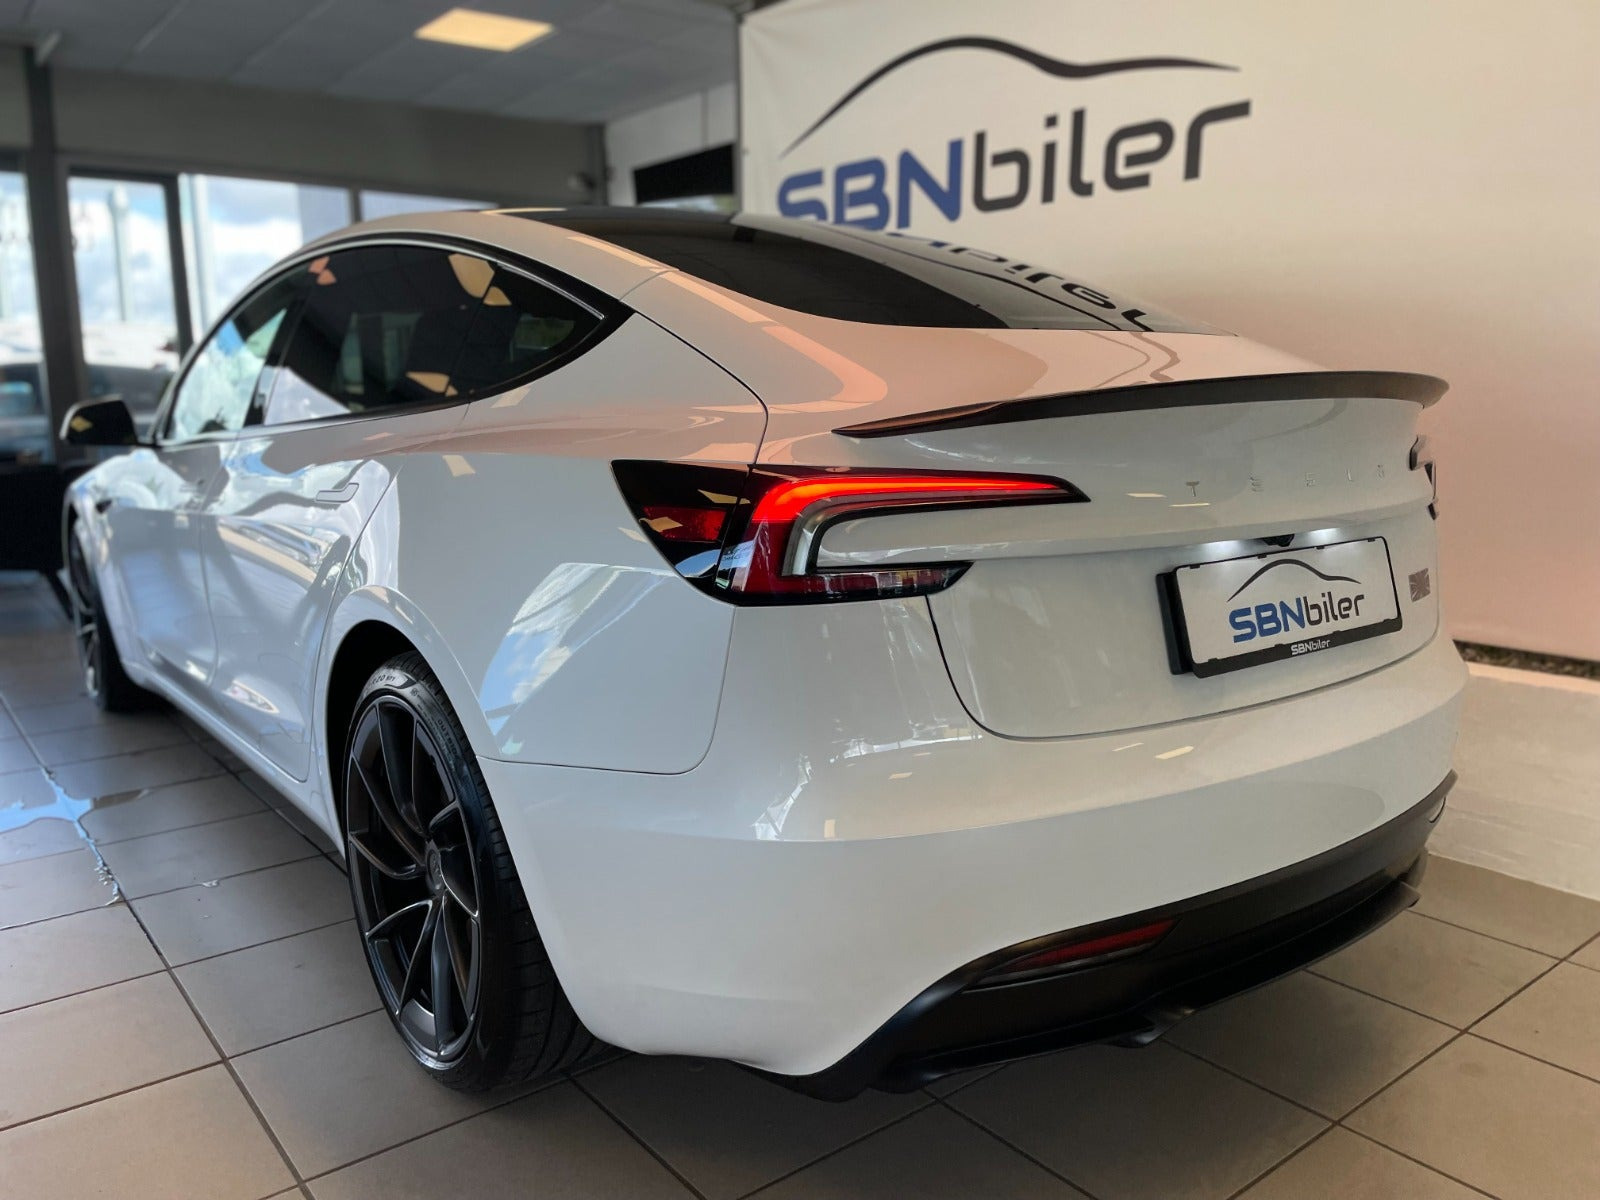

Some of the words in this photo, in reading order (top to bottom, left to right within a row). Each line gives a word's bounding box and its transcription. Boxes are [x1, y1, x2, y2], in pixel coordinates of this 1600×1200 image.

[777, 99, 1251, 231] SBNbiler
[1229, 592, 1365, 642] SBNbiler
[1290, 639, 1331, 656] SBNbiler
